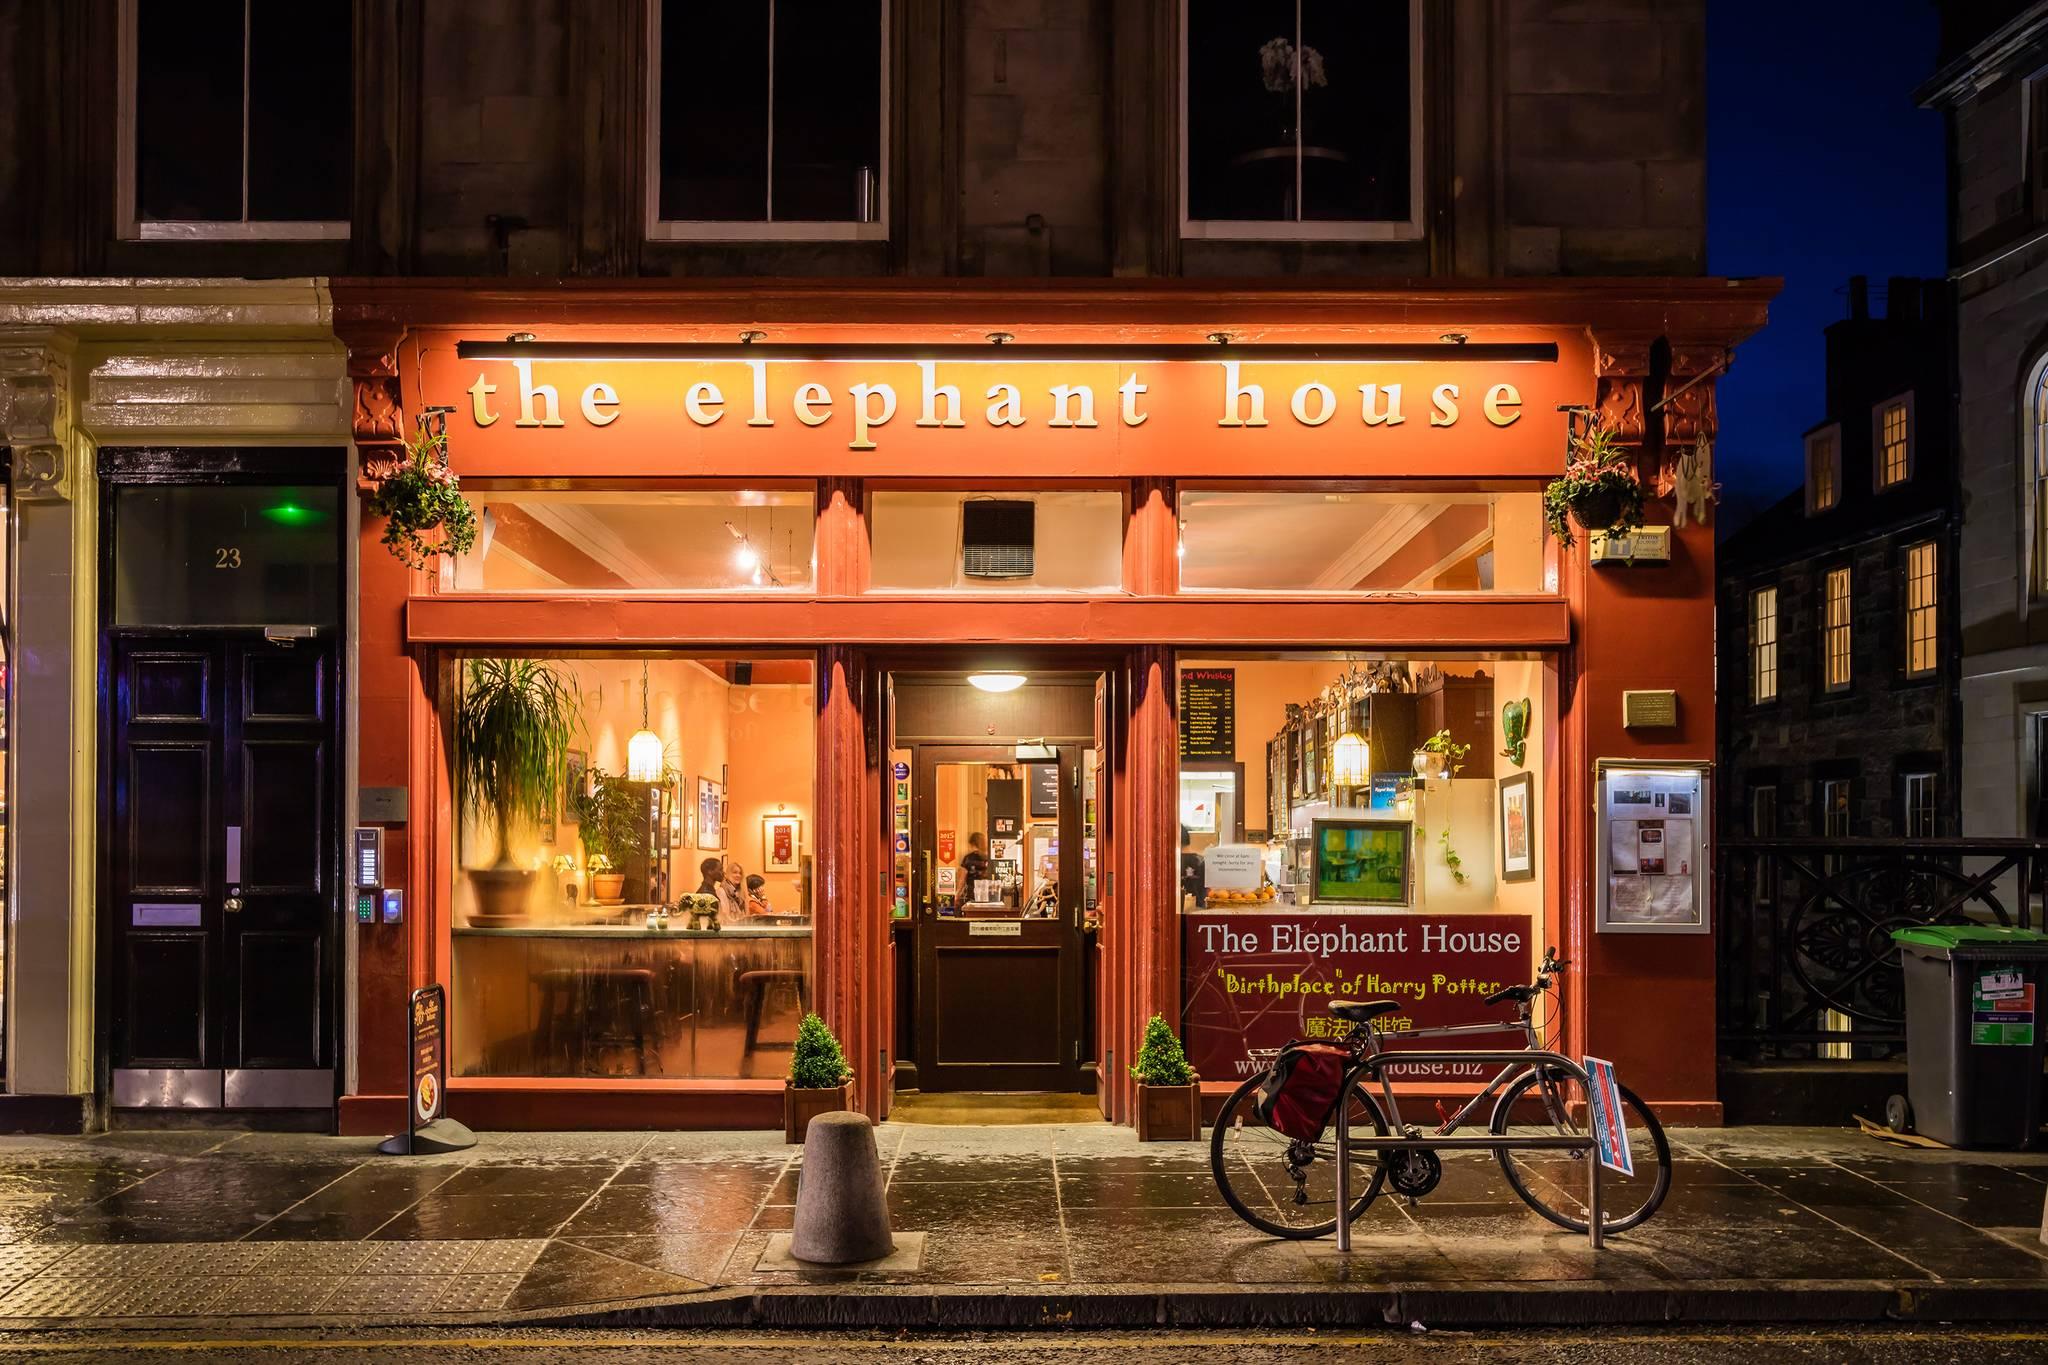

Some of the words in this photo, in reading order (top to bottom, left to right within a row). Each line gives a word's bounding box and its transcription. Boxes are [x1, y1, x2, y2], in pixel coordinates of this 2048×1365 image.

[467, 360, 621, 428] the
[685, 360, 1149, 450] elephant
[1218, 361, 1523, 428] house
[215, 548, 242, 569] 23
[1196, 671, 1233, 682] Whisky
[1198, 924, 1258, 953] The
[1271, 924, 1409, 958] Elephant
[1421, 924, 1521, 953] House
[1341, 973, 1364, 995] of
[1367, 973, 1426, 1000] Harry
[1432, 974, 1501, 995] Potter
